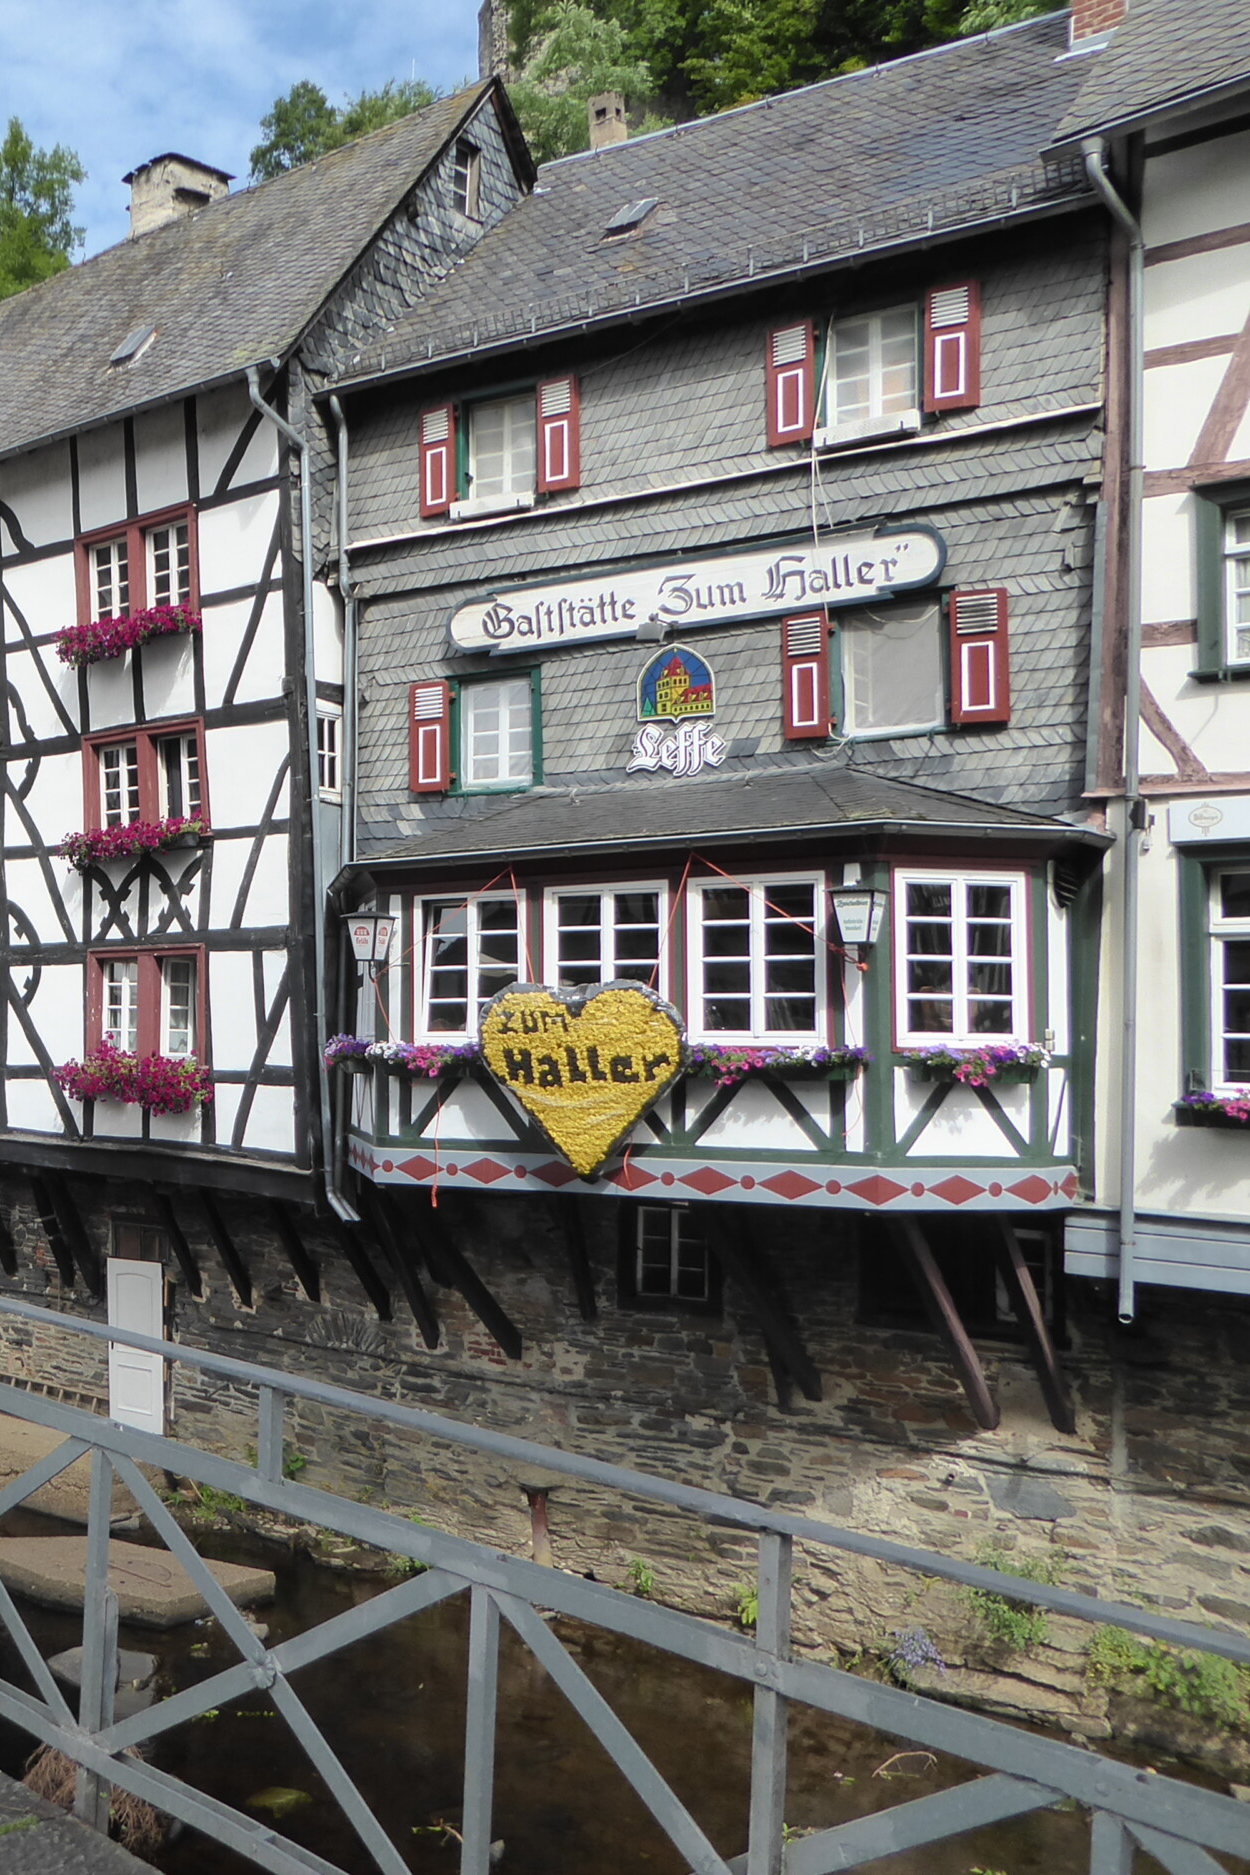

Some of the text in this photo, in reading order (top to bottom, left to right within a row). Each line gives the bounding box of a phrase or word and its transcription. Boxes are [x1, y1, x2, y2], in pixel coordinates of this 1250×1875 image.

[657, 573, 748, 616] Zum
[626, 722, 727, 777] Leffe
[502, 1045, 671, 1088] Haller
